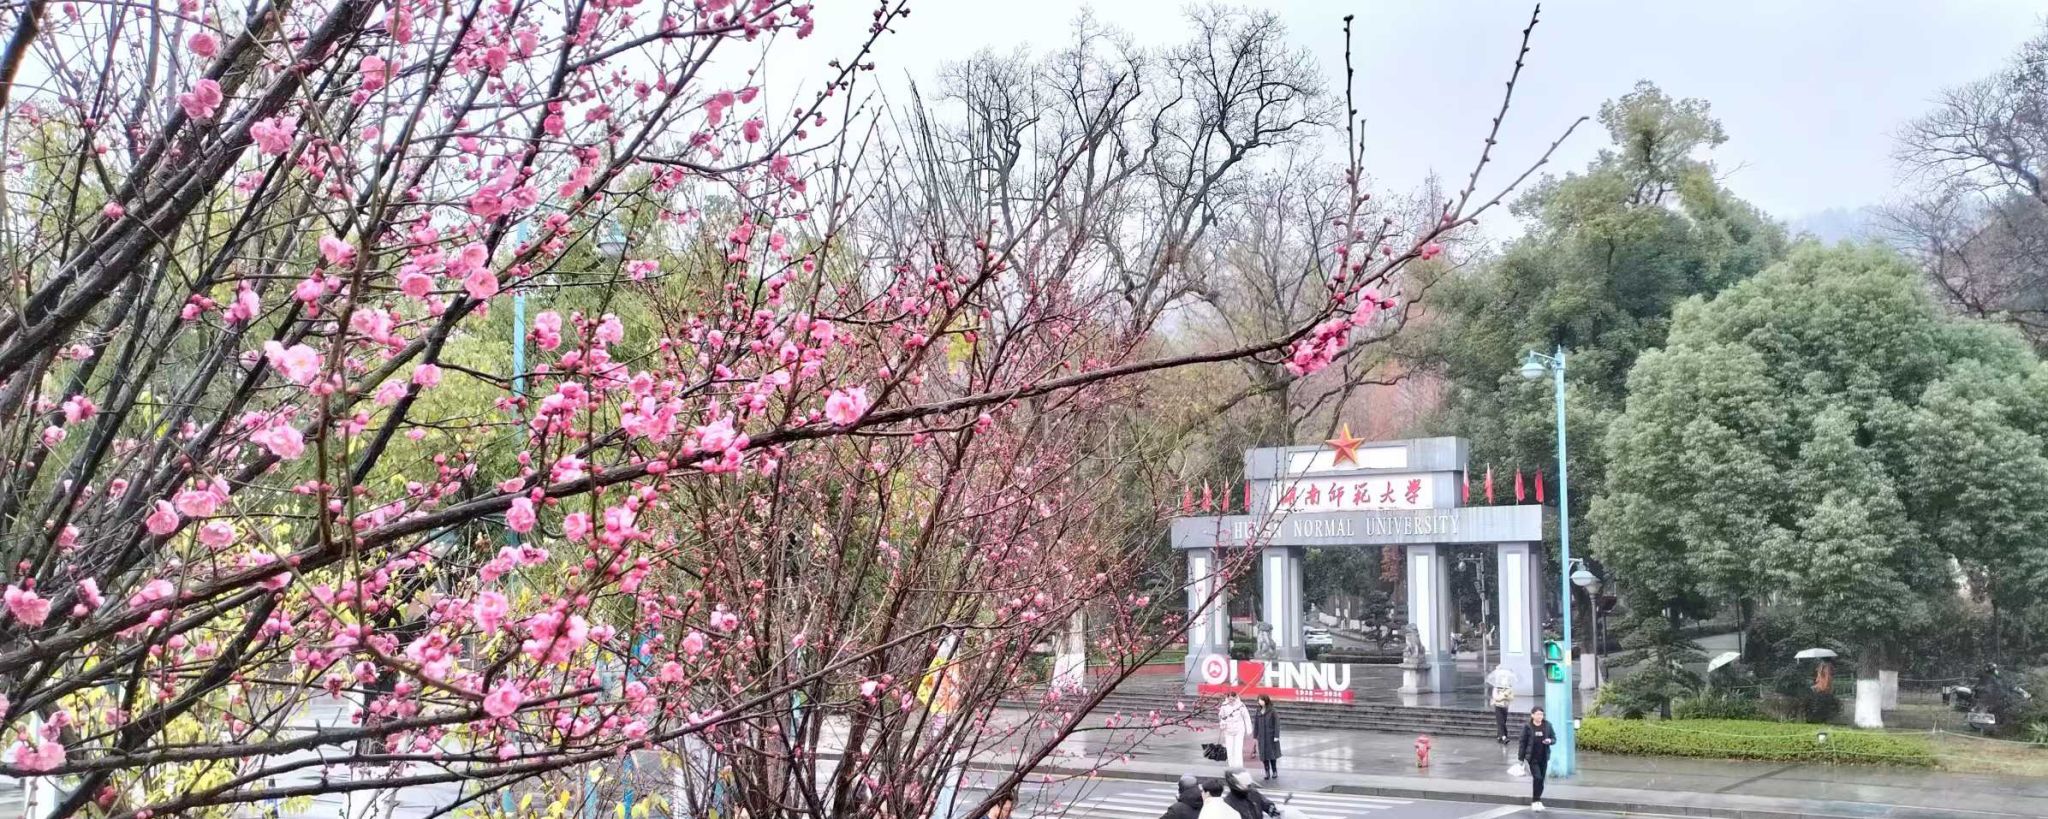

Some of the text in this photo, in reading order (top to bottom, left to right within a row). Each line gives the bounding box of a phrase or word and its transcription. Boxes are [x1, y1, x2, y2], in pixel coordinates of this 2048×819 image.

[1294, 519, 1354, 538] NORMAL
[1366, 515, 1459, 536] UNIVERSITY
[1230, 659, 1351, 691] I HNNU
